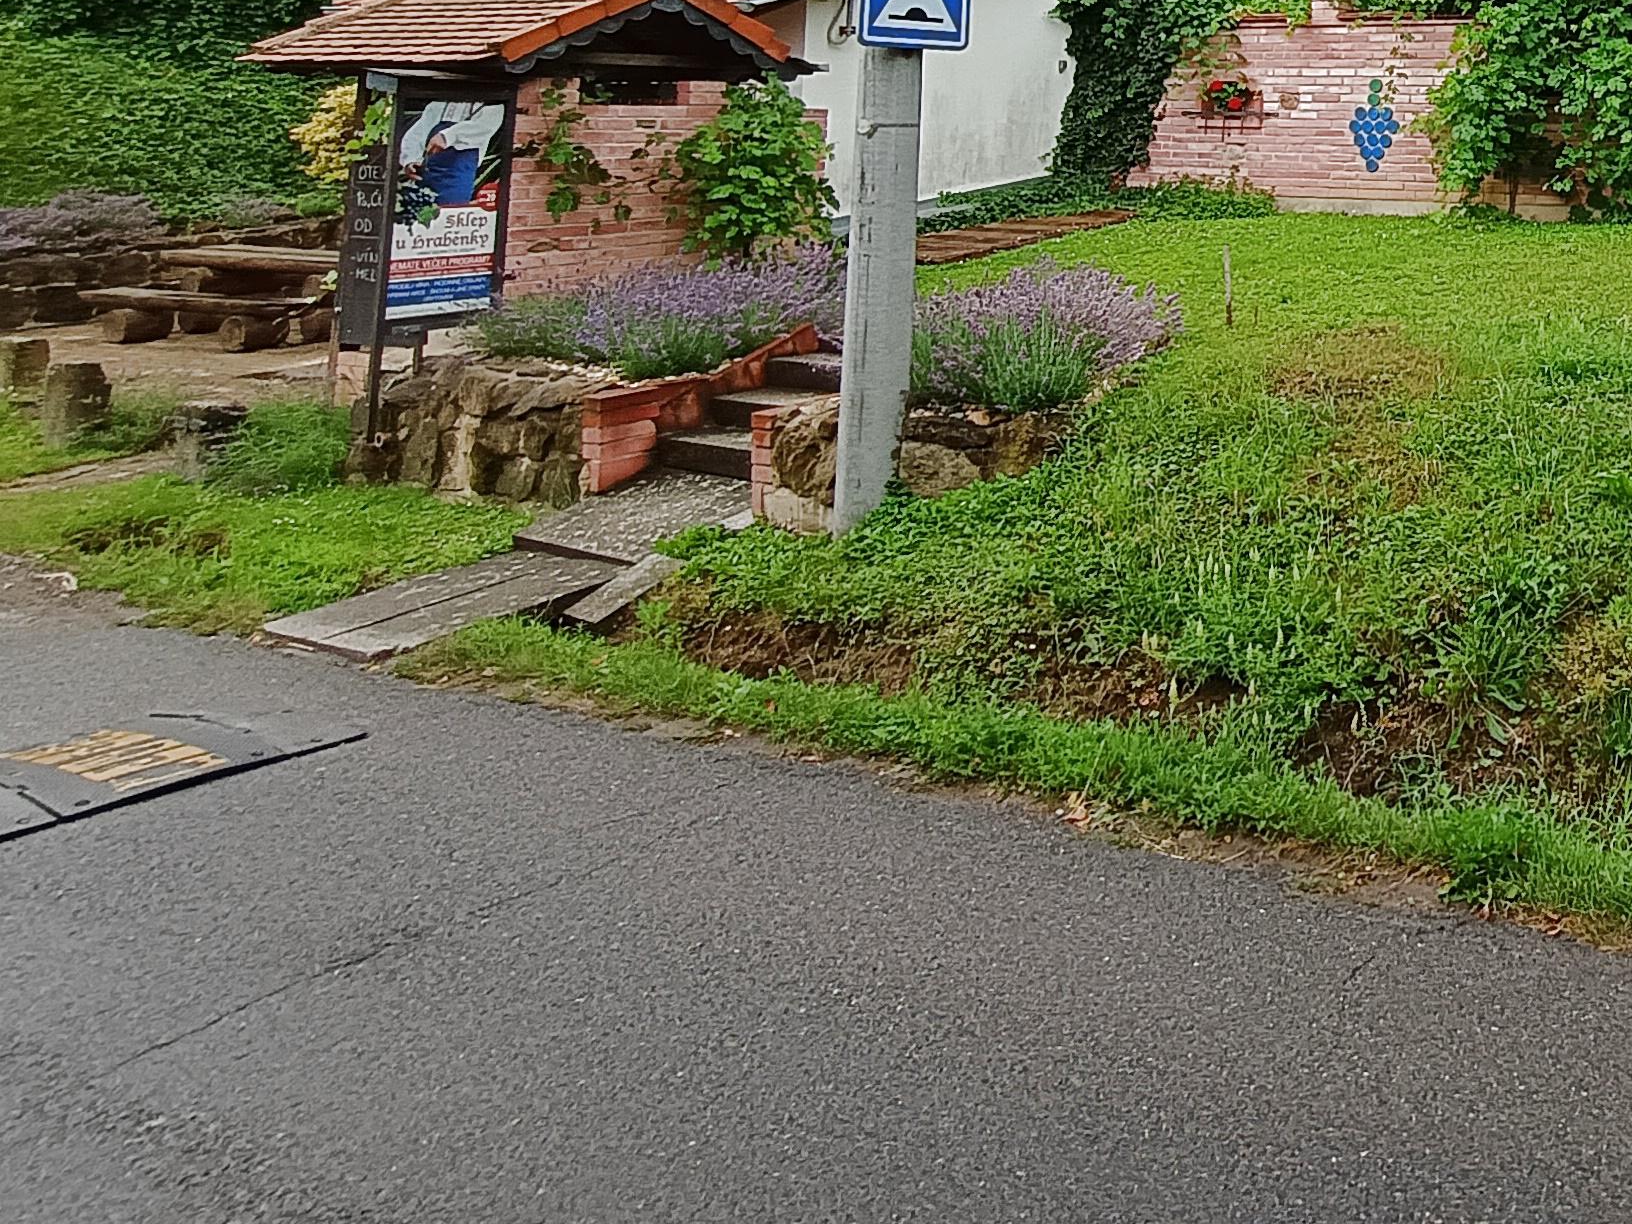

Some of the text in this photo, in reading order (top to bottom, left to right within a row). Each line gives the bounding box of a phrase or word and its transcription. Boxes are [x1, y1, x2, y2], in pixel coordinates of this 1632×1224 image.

[354, 217, 373, 233] OD
[445, 211, 488, 229] Sklep
[395, 239, 406, 249] u
